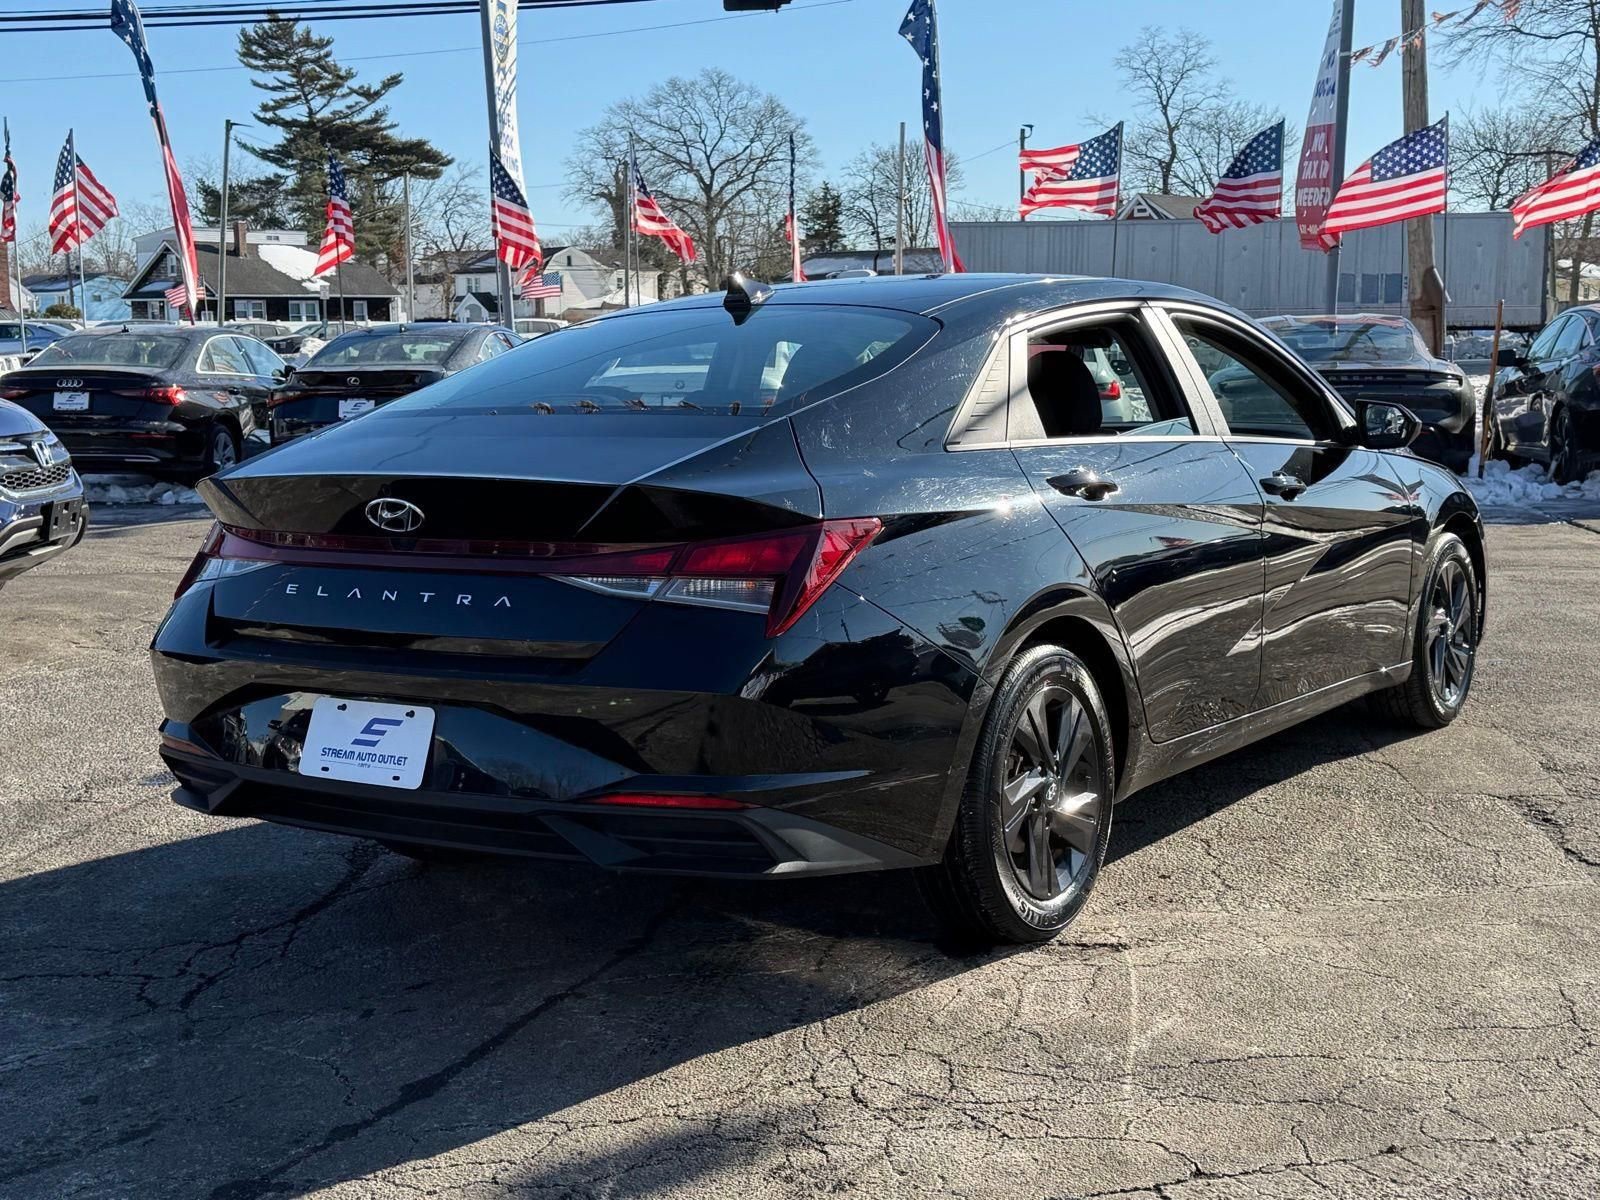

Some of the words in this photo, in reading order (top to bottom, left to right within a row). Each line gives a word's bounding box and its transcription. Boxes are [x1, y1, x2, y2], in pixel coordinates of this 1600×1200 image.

[1311, 133, 1326, 152] NO
[1303, 161, 1319, 179] TAX
[1297, 188, 1331, 206] NEEDED
[286, 584, 511, 607] ELANTRA
[321, 747, 355, 760] STREAM
[356, 751, 377, 763] AUTO
[379, 755, 408, 766] OUTLET
